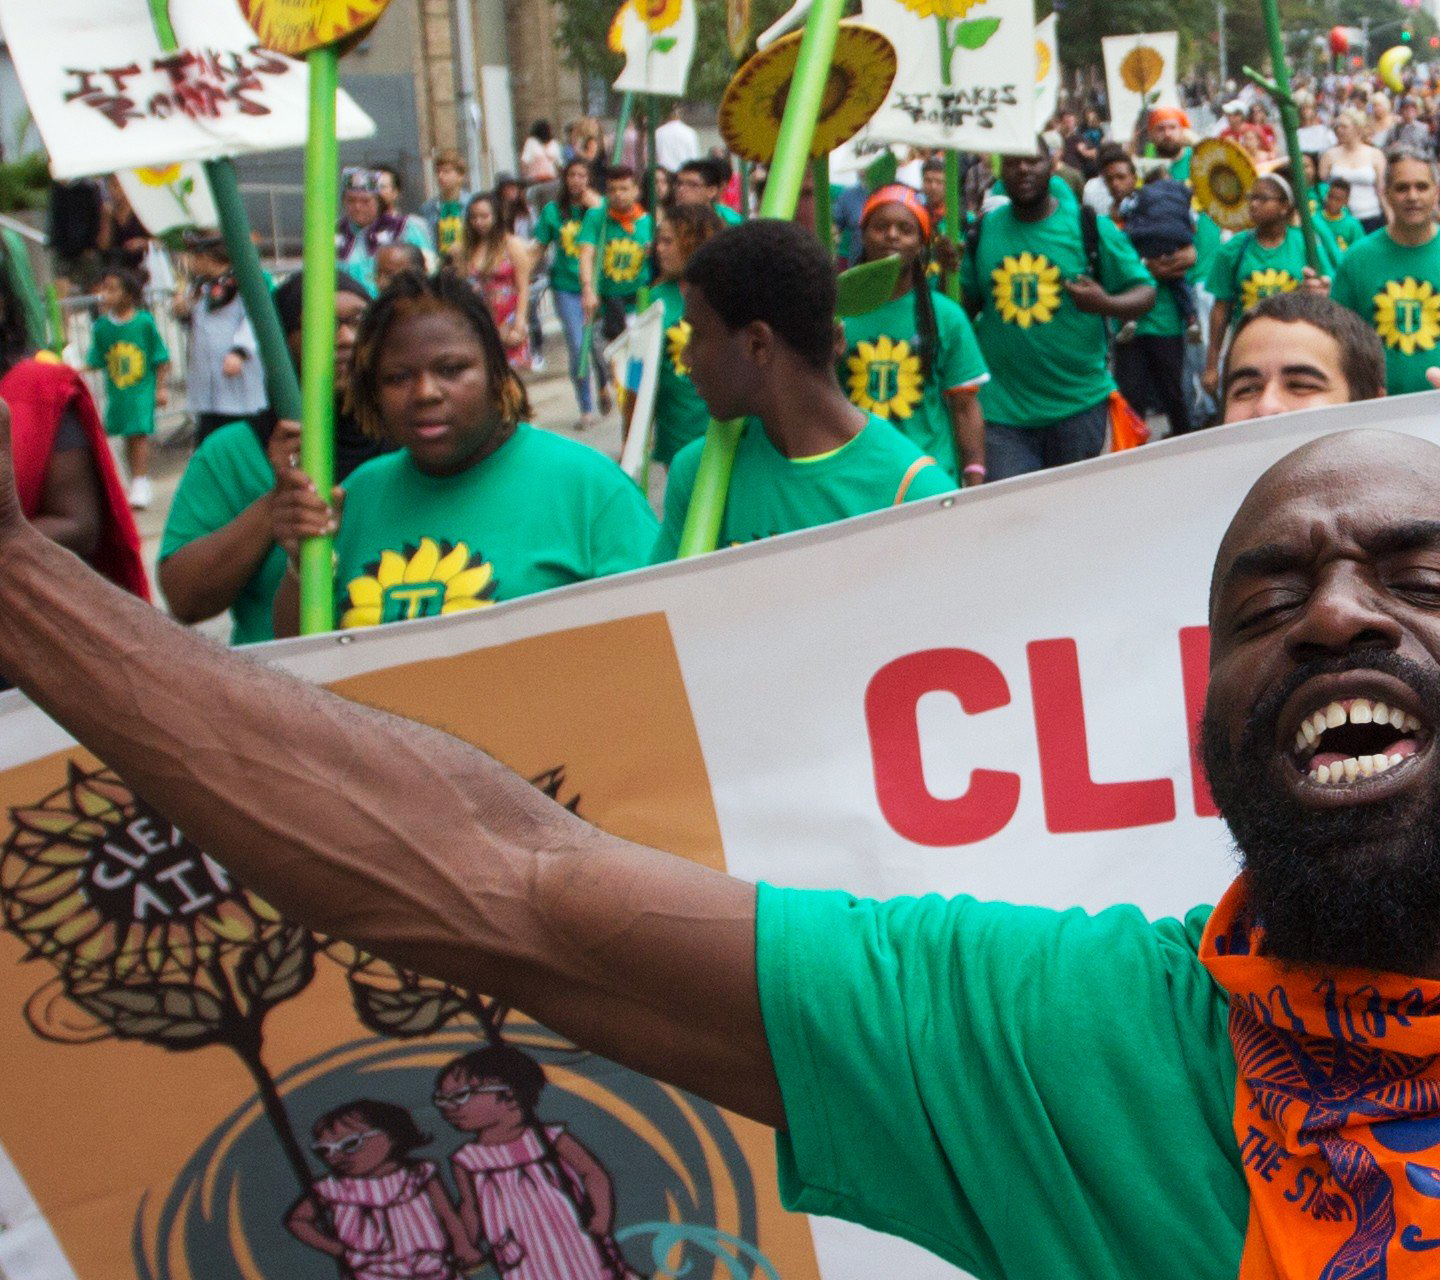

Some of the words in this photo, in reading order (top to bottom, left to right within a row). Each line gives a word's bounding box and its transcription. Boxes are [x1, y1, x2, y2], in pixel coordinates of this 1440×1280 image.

[63, 63, 141, 102] IT
[892, 91, 931, 109] IT
[1240, 1124, 1292, 1183] THE
